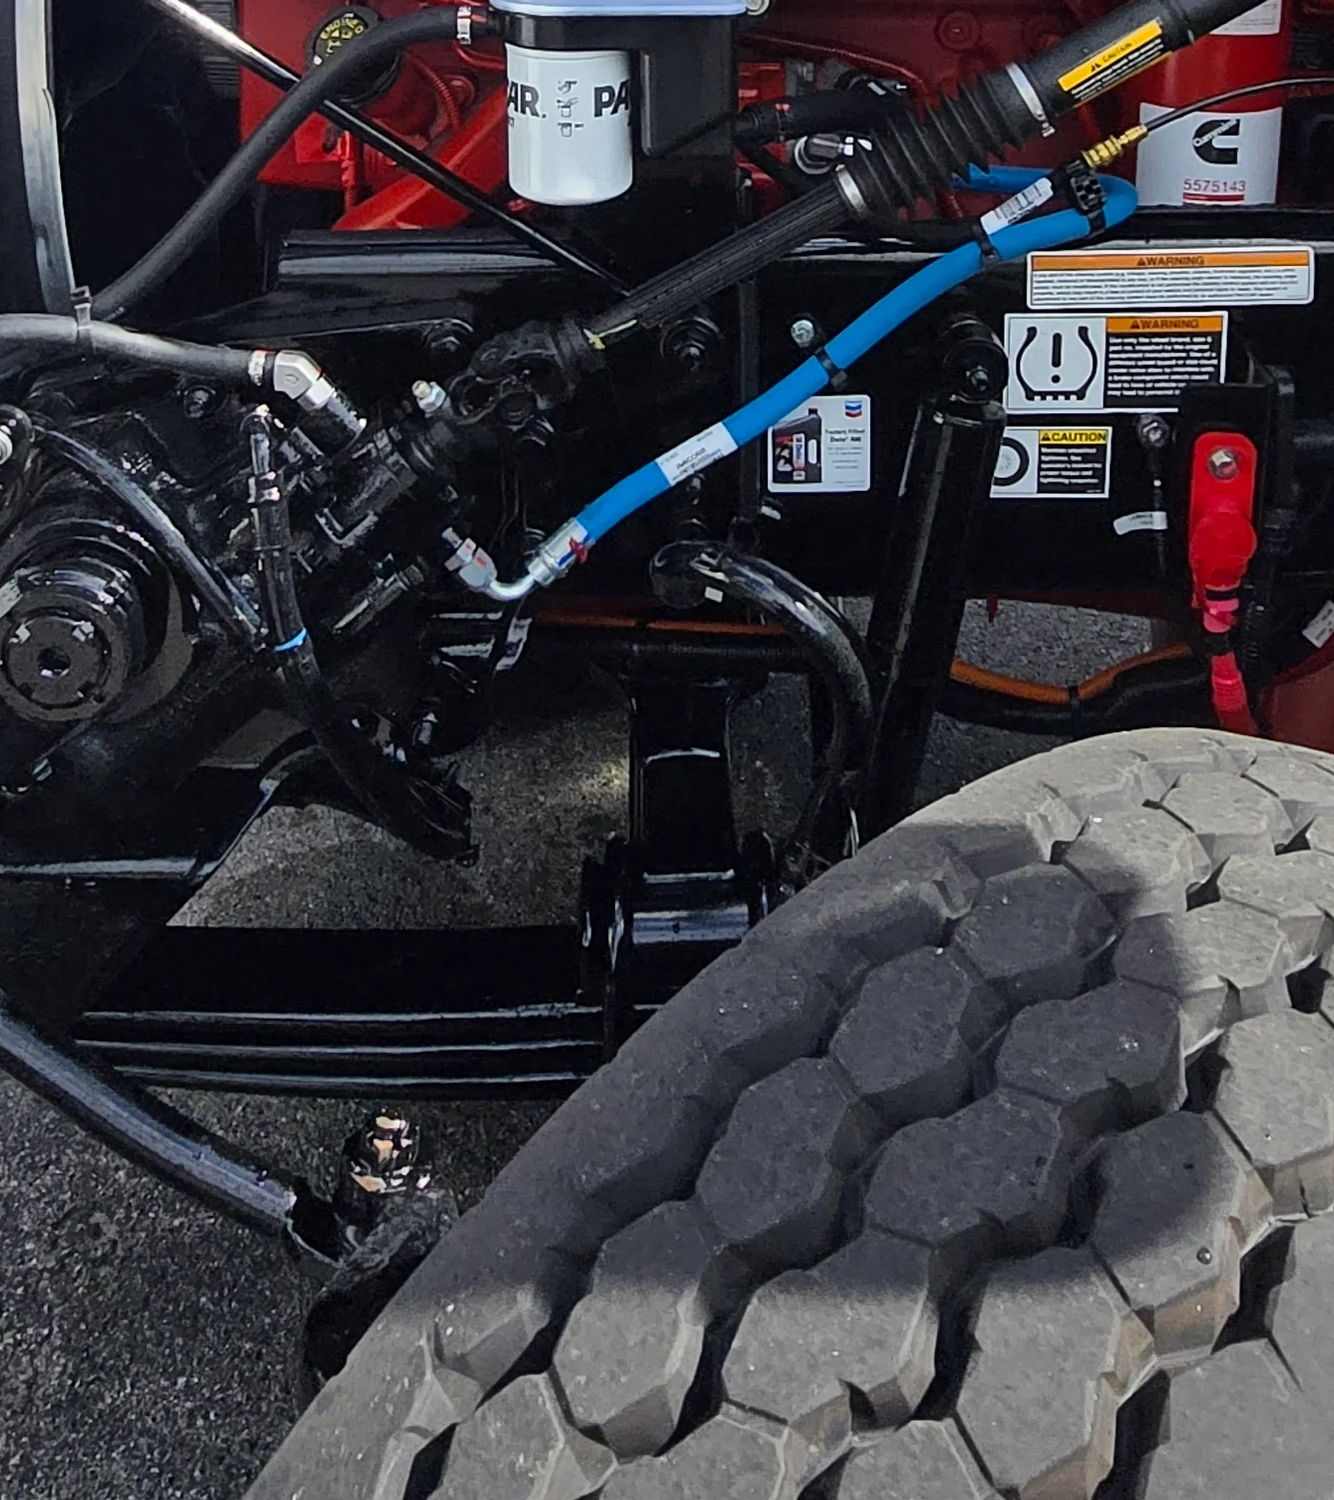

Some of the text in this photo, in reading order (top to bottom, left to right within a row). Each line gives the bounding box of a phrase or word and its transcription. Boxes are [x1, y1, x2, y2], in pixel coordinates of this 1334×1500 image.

[1183, 179, 1246, 193] 5575143
[1147, 255, 1205, 266] WARNING
[1140, 319, 1199, 329] WARNING
[1051, 432, 1106, 441] CAUTION
